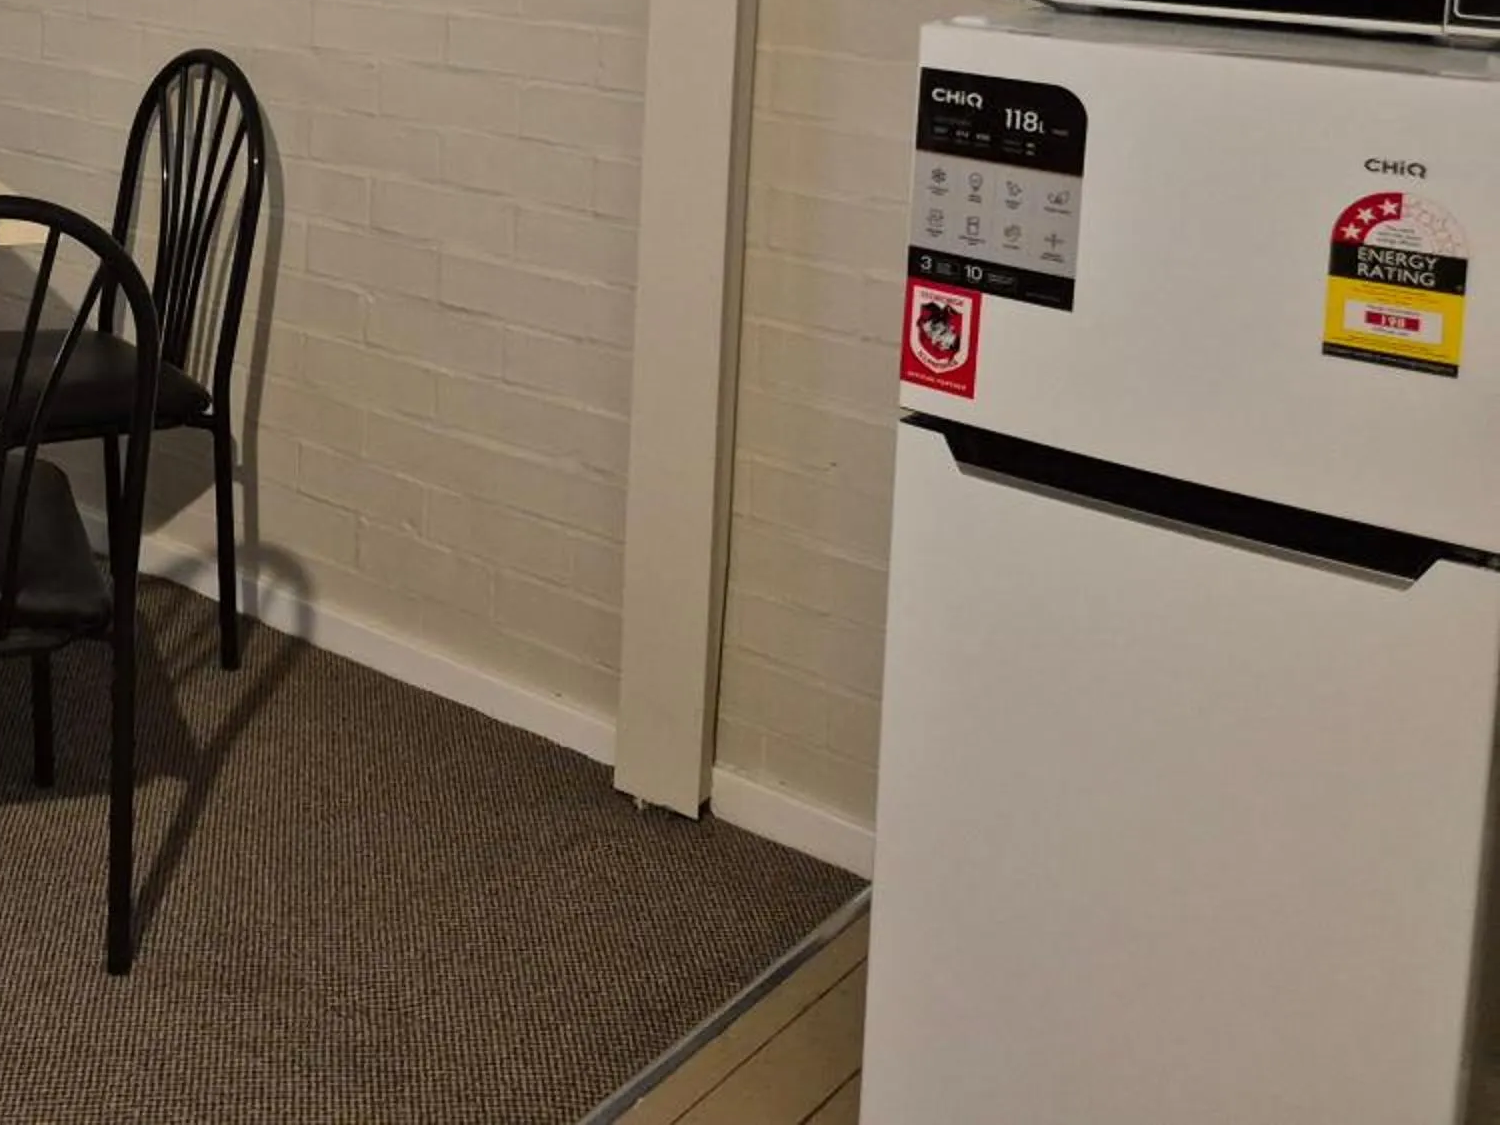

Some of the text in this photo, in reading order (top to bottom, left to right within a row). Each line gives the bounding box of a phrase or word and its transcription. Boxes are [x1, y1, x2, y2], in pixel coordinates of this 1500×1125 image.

[920, 256, 933, 271] 3
[1357, 246, 1440, 270] ENERGY
[964, 265, 983, 281] 10
[1357, 263, 1437, 287] RATING
